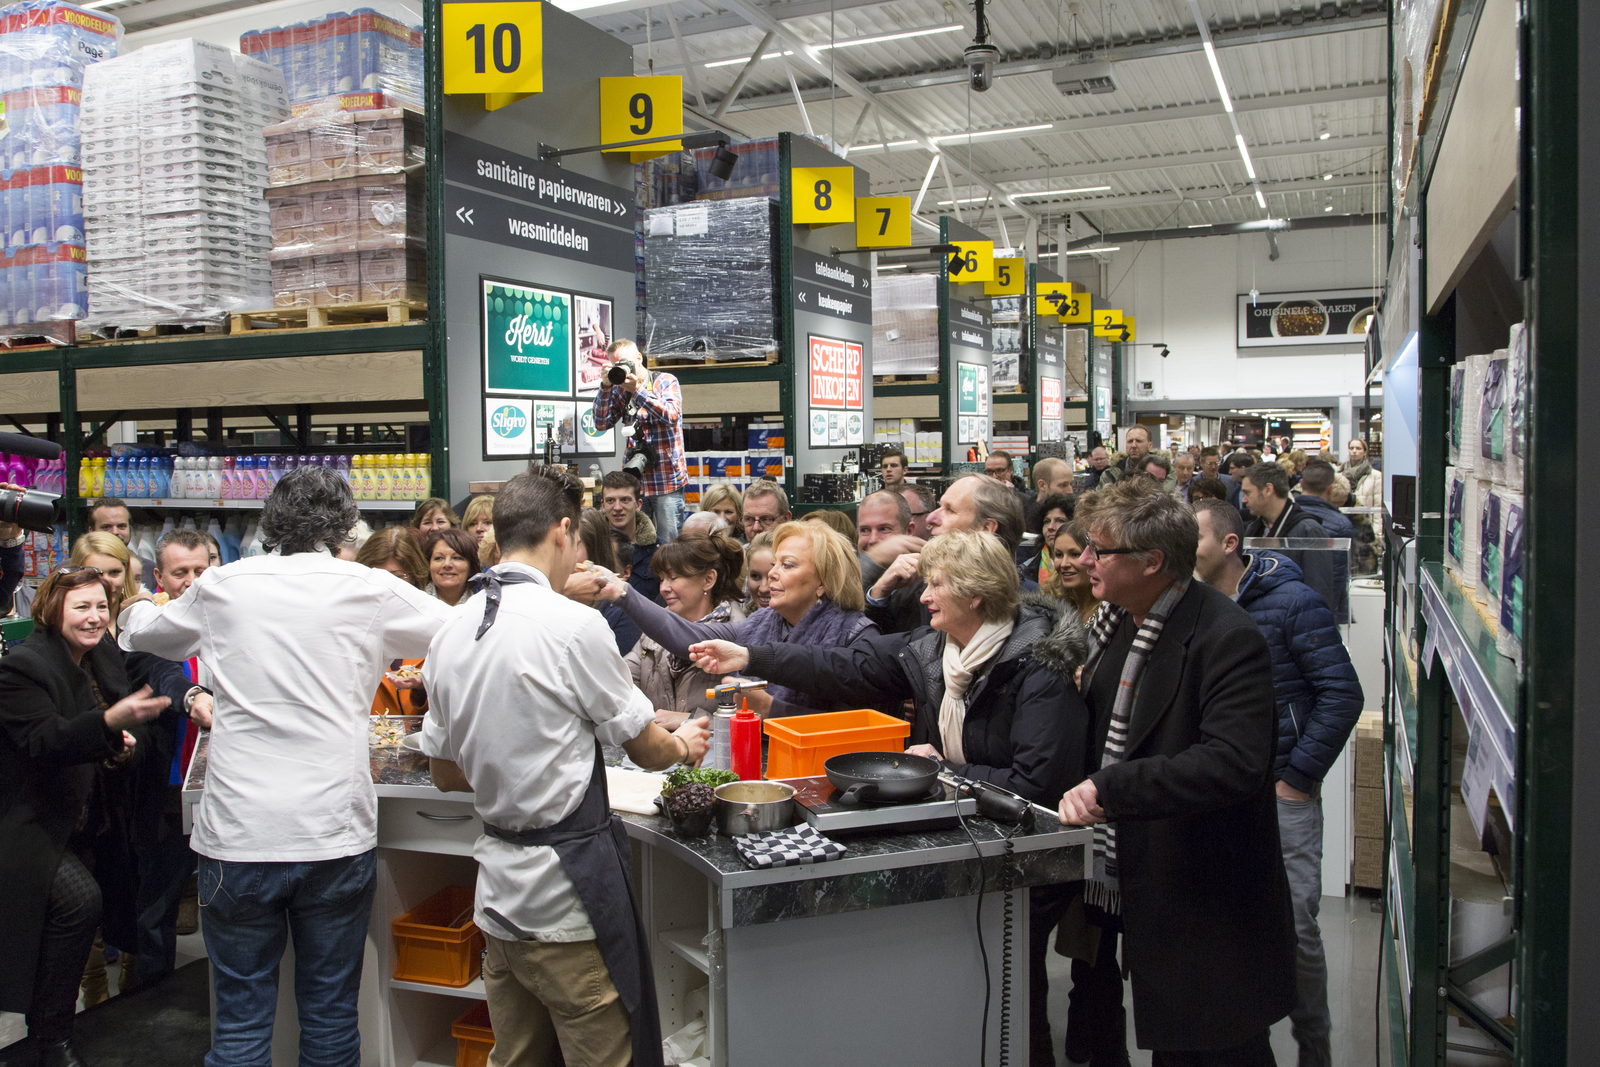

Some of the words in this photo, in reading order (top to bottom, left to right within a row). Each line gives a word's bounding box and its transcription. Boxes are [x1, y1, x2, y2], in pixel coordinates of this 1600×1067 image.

[466, 23, 521, 74] 10
[629, 93, 654, 135] 9
[477, 159, 536, 191] sanitaire
[539, 179, 611, 213] papierwaren
[814, 179, 832, 211] 8
[508, 218, 589, 251] wasmiddelen
[875, 208, 891, 236] 7
[965, 250, 978, 272] 6
[815, 261, 854, 288] tafelaankleding
[998, 265, 1010, 286] 5
[818, 292, 852, 316] keukenpapier
[1071, 300, 1080, 316] 3
[1254, 306, 1310, 317] ORIGINELE
[1312, 304, 1356, 314] SMAKEN
[505, 314, 553, 353] Kerst
[1104, 316, 1113, 330] 2
[510, 355, 527, 363] WORDT
[813, 344, 860, 375] SCHERP
[813, 376, 860, 401] INKOPEN
[492, 412, 526, 431] Sligro
[582, 414, 597, 431] Sli
